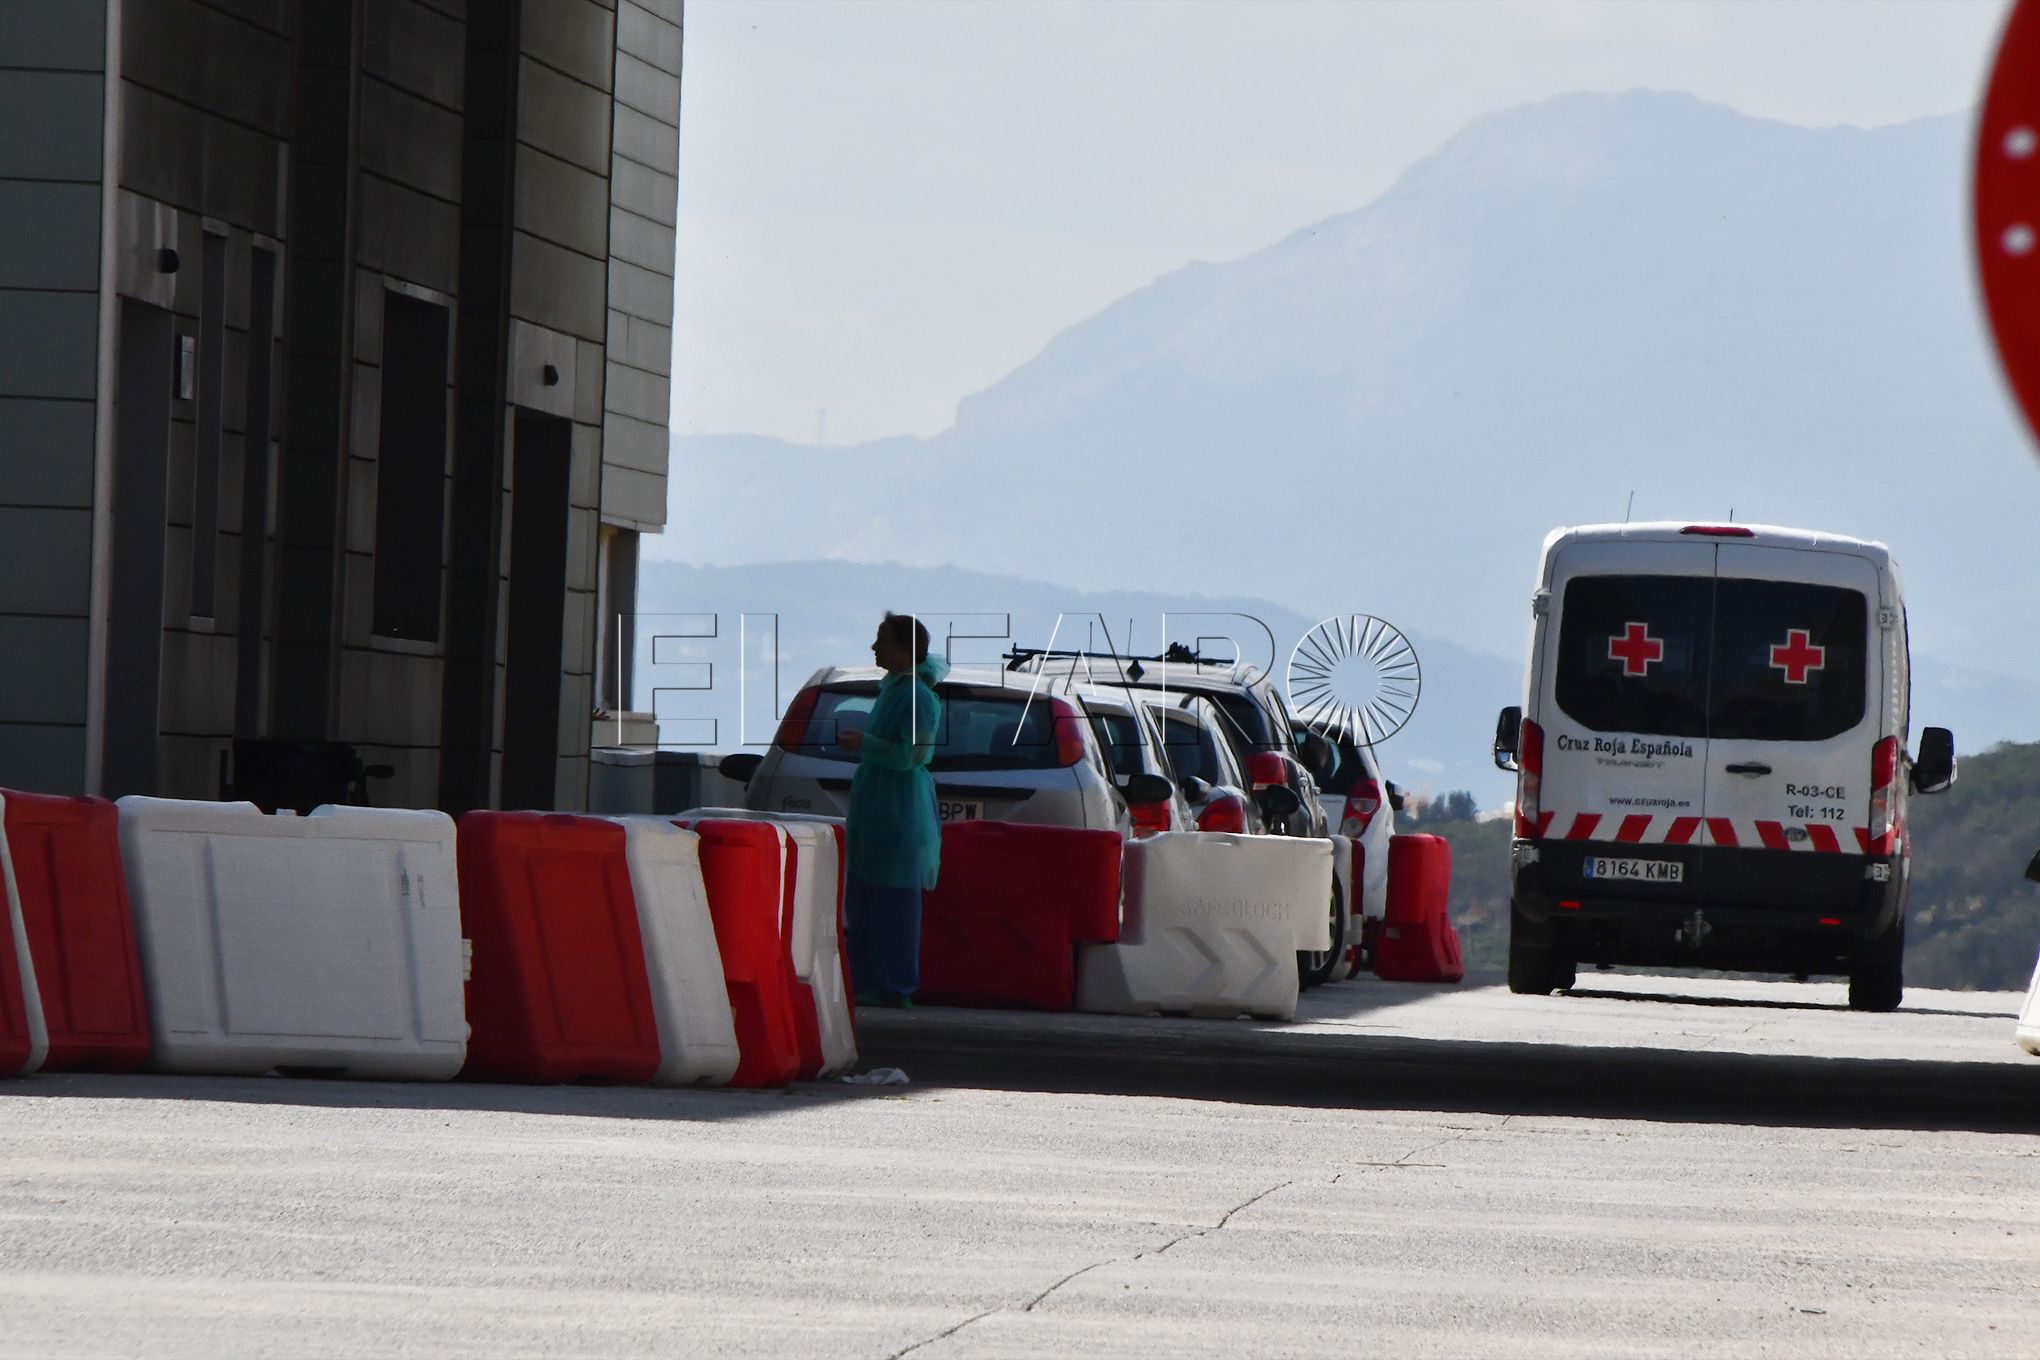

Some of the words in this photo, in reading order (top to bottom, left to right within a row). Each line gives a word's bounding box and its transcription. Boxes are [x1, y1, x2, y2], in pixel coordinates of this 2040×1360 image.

[1557, 734, 1590, 751] Cruz
[1594, 737, 1627, 756] Roja
[1630, 738, 1693, 759] Española
[1786, 783, 1846, 800] R-03-CE
[1608, 796, 1691, 809] www.cruzroja.es
[1788, 804, 1814, 819] Tel:
[1820, 806, 1845, 820] 112
[1596, 860, 1640, 877] 8164
[1645, 862, 1680, 880] KMB
